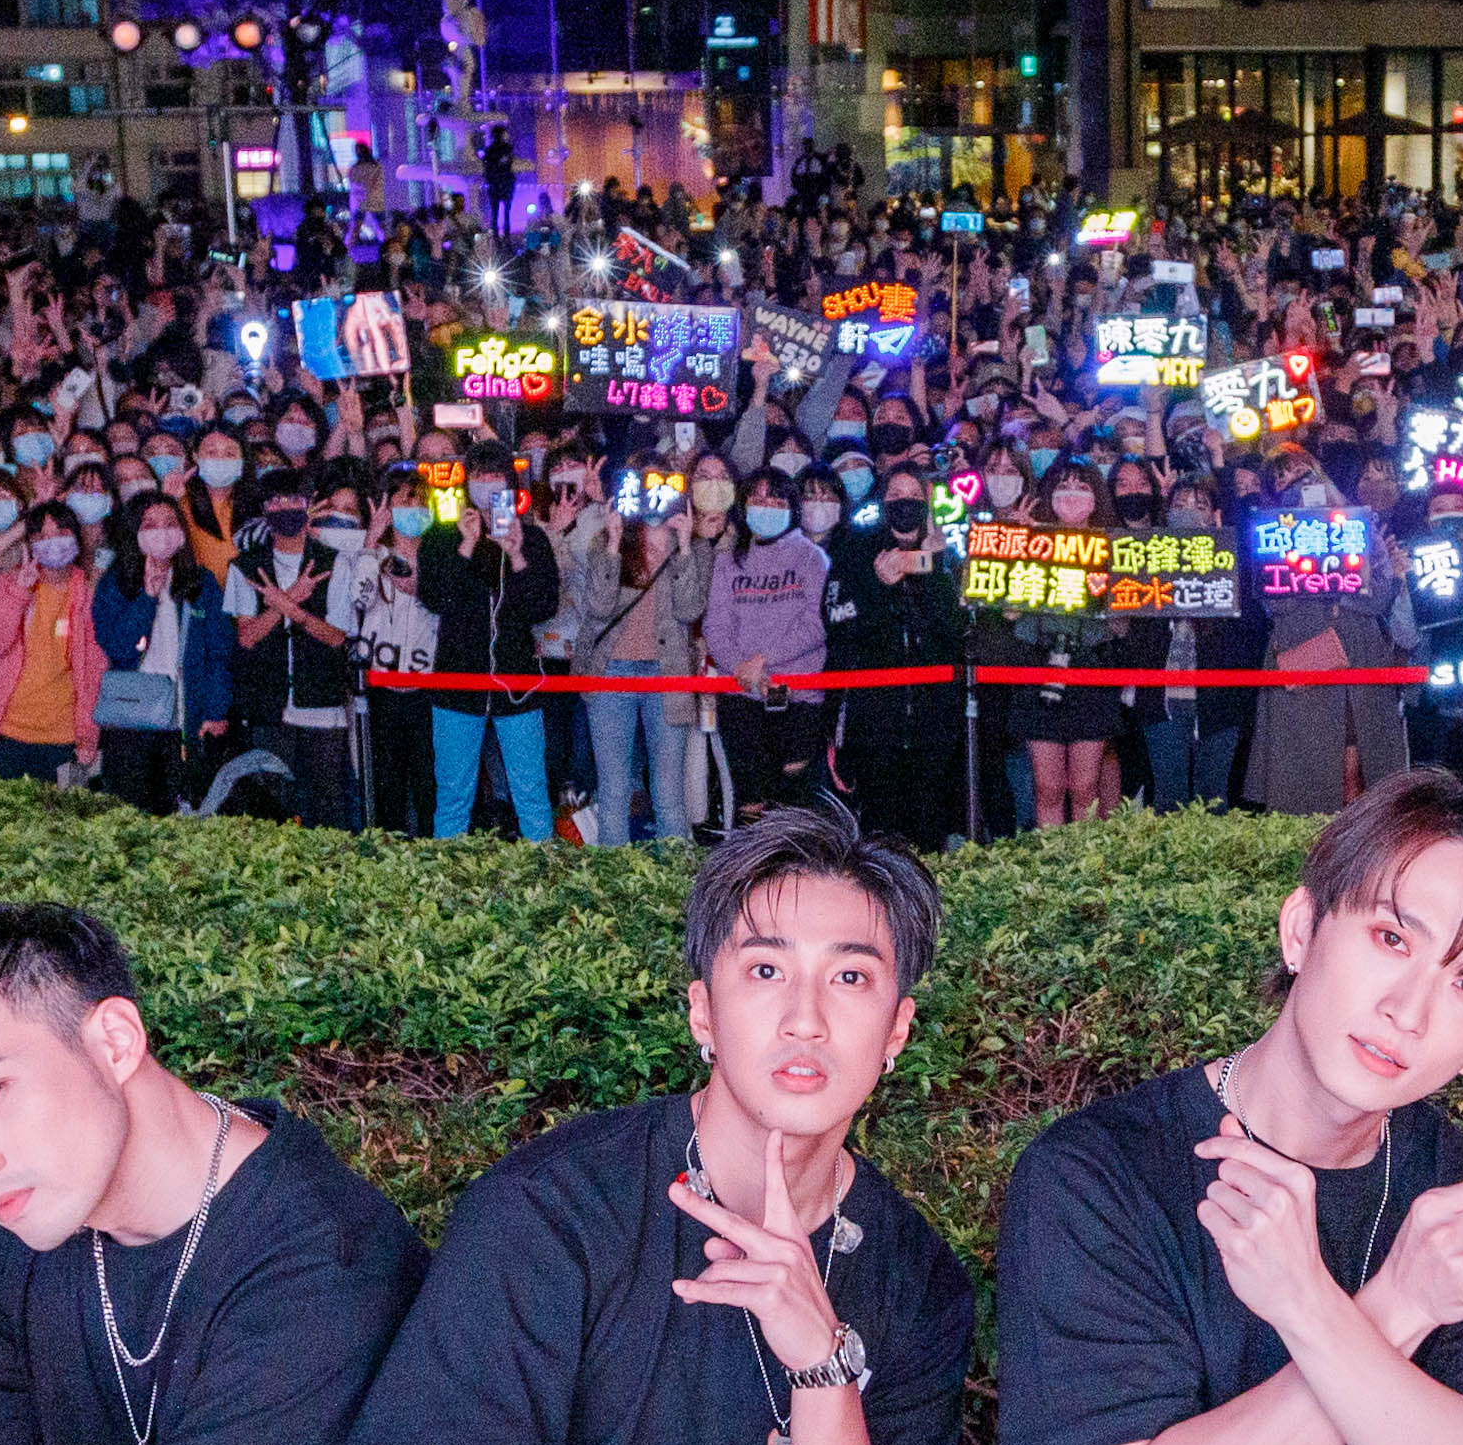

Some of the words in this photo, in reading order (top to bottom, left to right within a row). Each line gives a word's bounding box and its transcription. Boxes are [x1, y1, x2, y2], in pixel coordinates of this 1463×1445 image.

[755, 306, 829, 352] WAYNE
[1097, 317, 1206, 354] 陳零九
[456, 346, 553, 379] FengZe
[1154, 357, 1205, 386] MRT
[1203, 361, 1298, 415] 零九
[1112, 534, 1235, 575] 邱鋒澤の
[1255, 519, 1366, 558] 邱鋒澤
[966, 560, 1087, 612] 邱鋒澤
[1263, 564, 1362, 594] Irene
